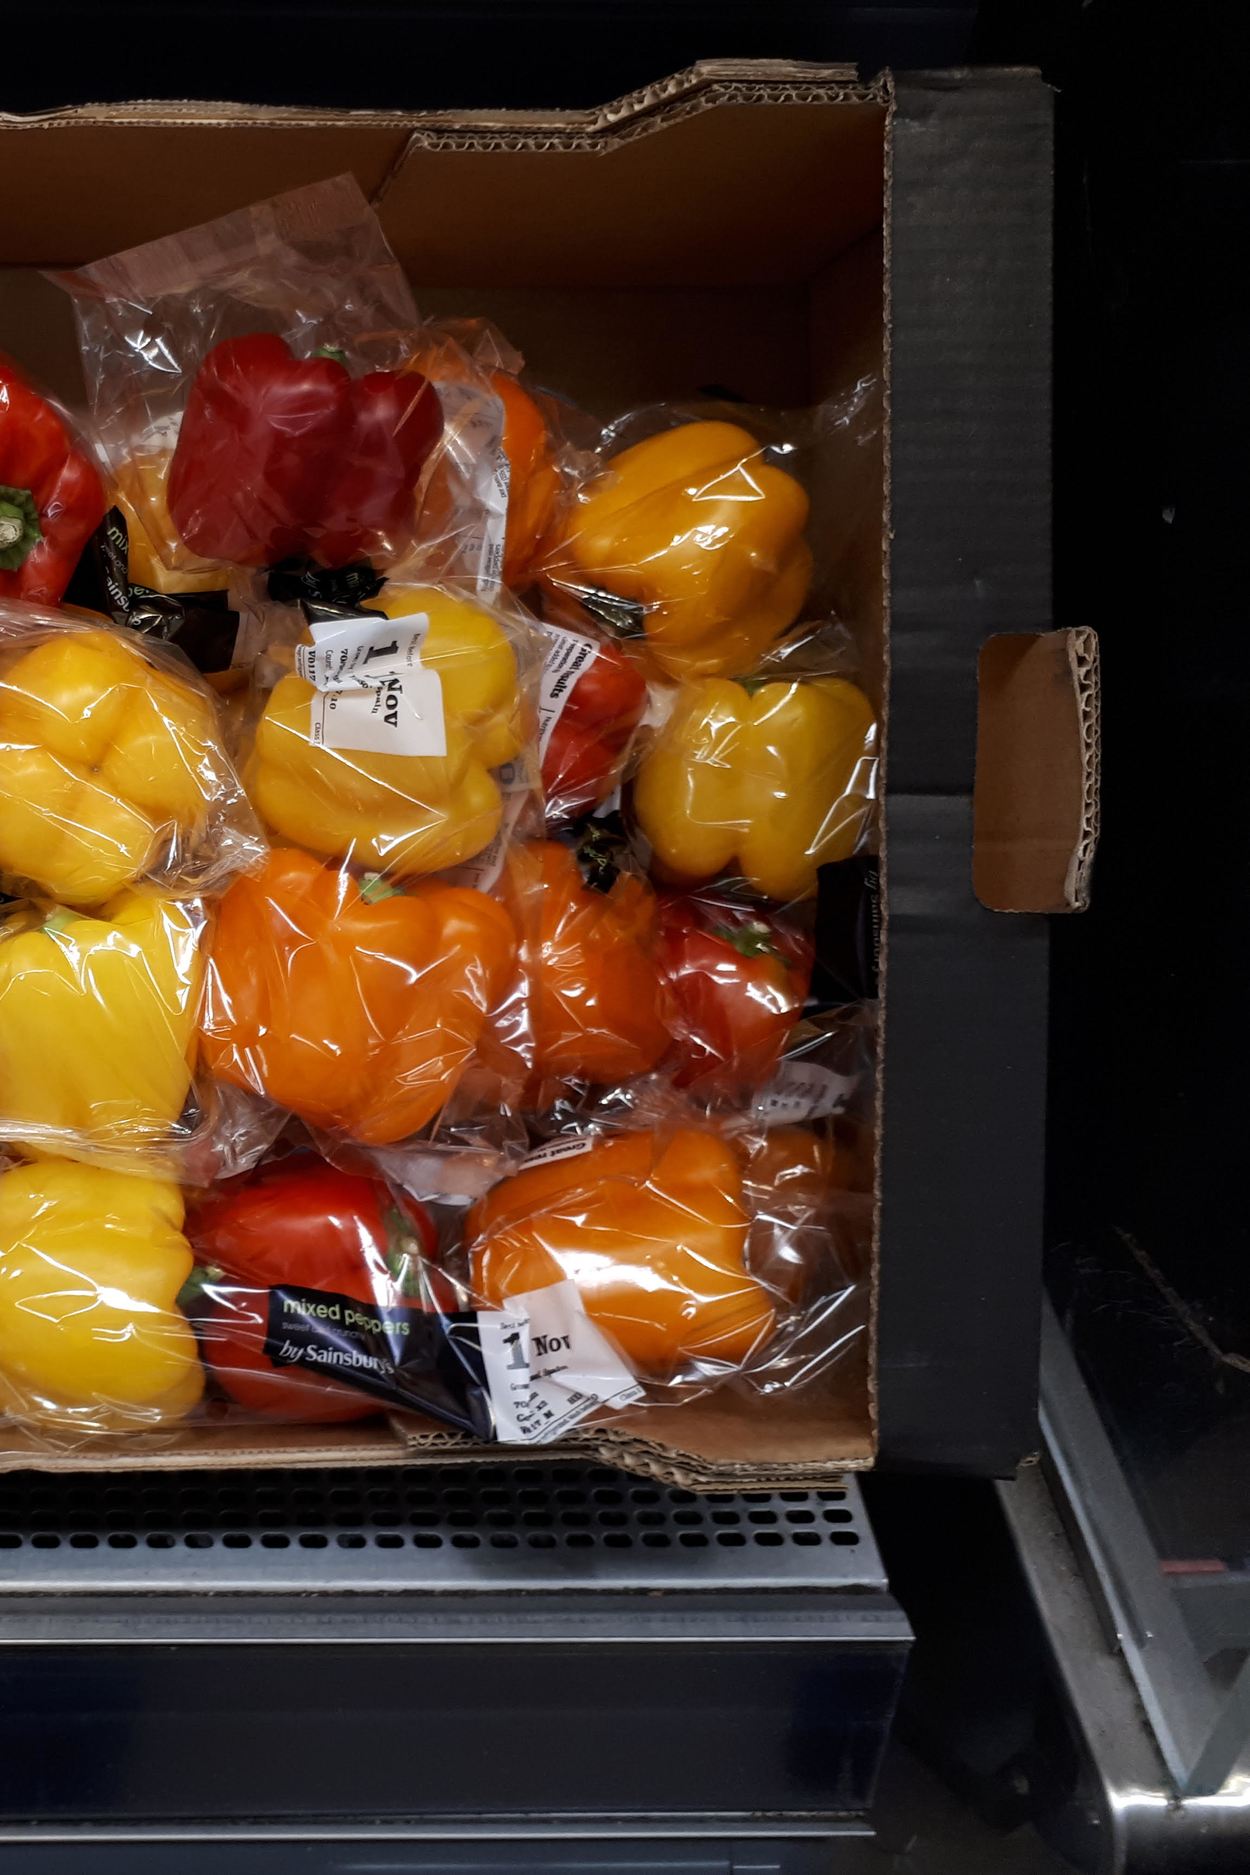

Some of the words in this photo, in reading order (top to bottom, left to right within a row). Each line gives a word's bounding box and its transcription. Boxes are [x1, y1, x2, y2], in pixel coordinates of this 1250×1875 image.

[379, 678, 403, 728] Nov
[281, 1321, 310, 1332] sweet
[283, 1298, 341, 1320] mixed
[344, 1309, 410, 1336] peppers
[278, 1339, 304, 1363] by
[305, 1344, 395, 1375] Sainsbury's
